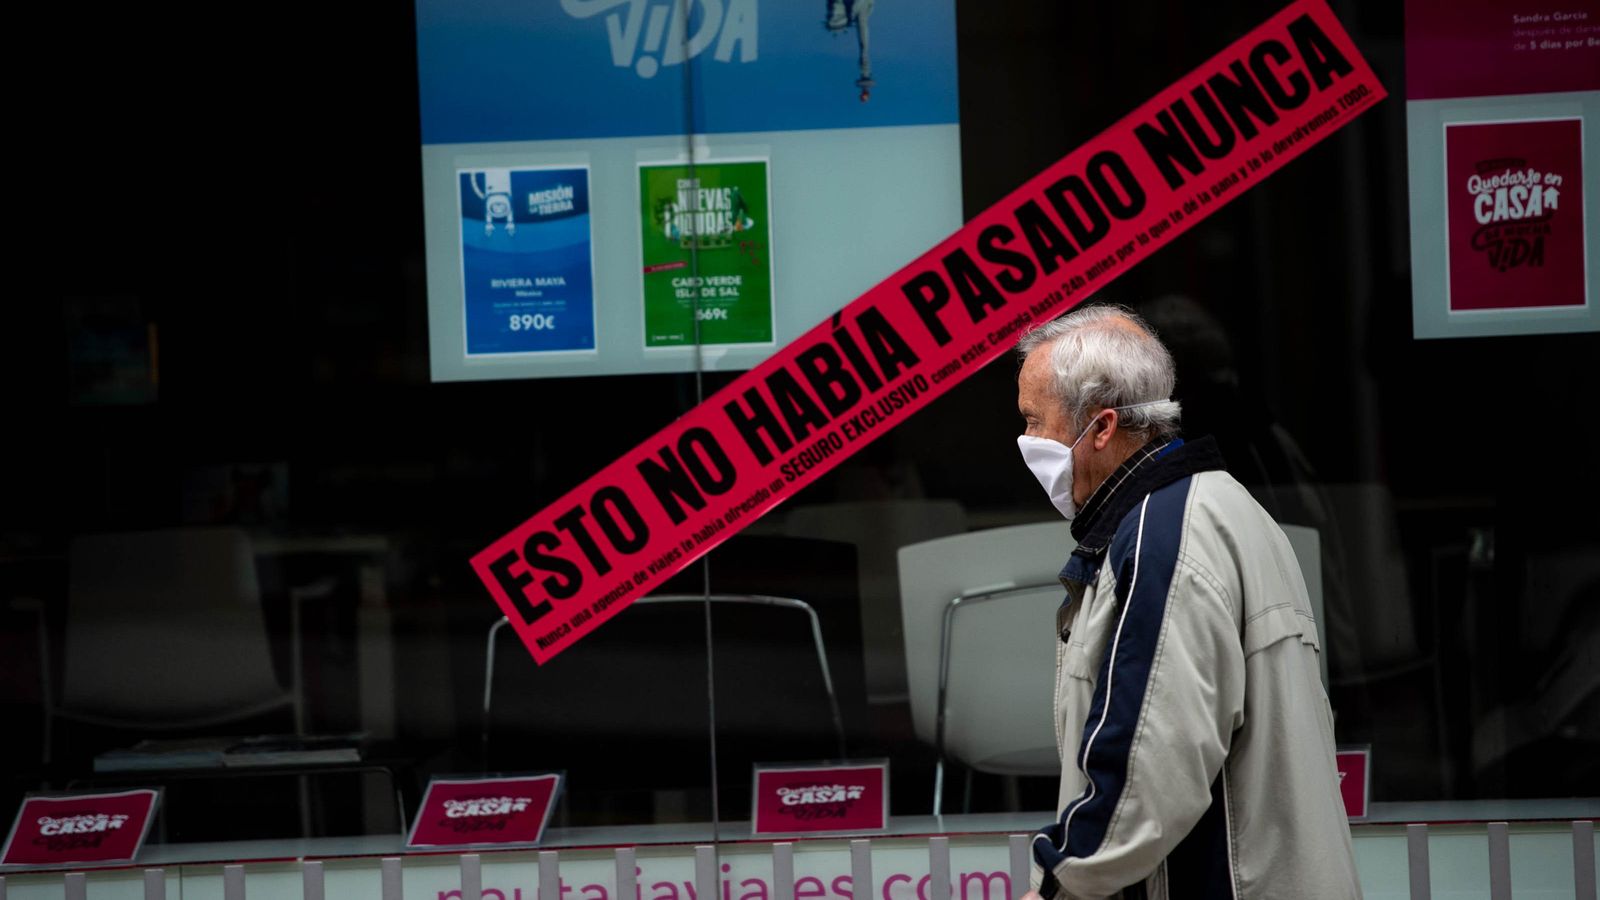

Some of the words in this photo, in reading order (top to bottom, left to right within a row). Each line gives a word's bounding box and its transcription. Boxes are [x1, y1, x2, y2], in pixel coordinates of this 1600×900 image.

[1514, 13, 1549, 23] Sandra
[1566, 40, 1583, 50] por
[1468, 169, 1540, 195] Quedarse
[1544, 173, 1562, 186] en
[529, 184, 573, 204] MISIÓN
[539, 199, 574, 215] TIERRA
[1475, 185, 1542, 225] CASA
[491, 278, 532, 288] RIVIERA
[535, 277, 565, 286] MAYA
[672, 277, 703, 287] CABO
[706, 275, 742, 285] VERDE
[675, 289, 699, 298] ISLA
[702, 288, 716, 297] DE
[719, 287, 739, 296] SAL
[490, 487, 648, 624] ESTO
[638, 429, 735, 524] NO
[723, 305, 921, 467] HABÍA
[902, 152, 1145, 346] PASADO
[1135, 14, 1353, 190] NUNCA
[509, 314, 555, 330] 890€
[571, 609, 592, 627] una
[593, 581, 634, 613] agencia
[633, 571, 648, 585] de
[648, 548, 681, 574] viajes
[725, 489, 770, 523] ofrecido
[770, 479, 784, 493] un
[781, 433, 842, 481] SEGURO
[841, 375, 928, 441] EXCLUSIVO
[931, 360, 961, 384] como
[987, 312, 1032, 345] Cancela
[1030, 291, 1063, 316] hasta
[1062, 276, 1085, 296] 24h
[1085, 255, 1116, 281] antes
[1116, 240, 1134, 261] por
[1136, 233, 1150, 245] lo
[1149, 219, 1171, 238] que
[1169, 210, 1184, 223] te
[1197, 192, 1211, 205] la
[1211, 173, 1240, 197] gana
[1238, 167, 1248, 179] y
[1246, 158, 1261, 172] te
[1273, 106, 1340, 155] devolvemos
[782, 790, 846, 805] CASA
[446, 802, 511, 817] CASA
[41, 818, 107, 835] CASA
